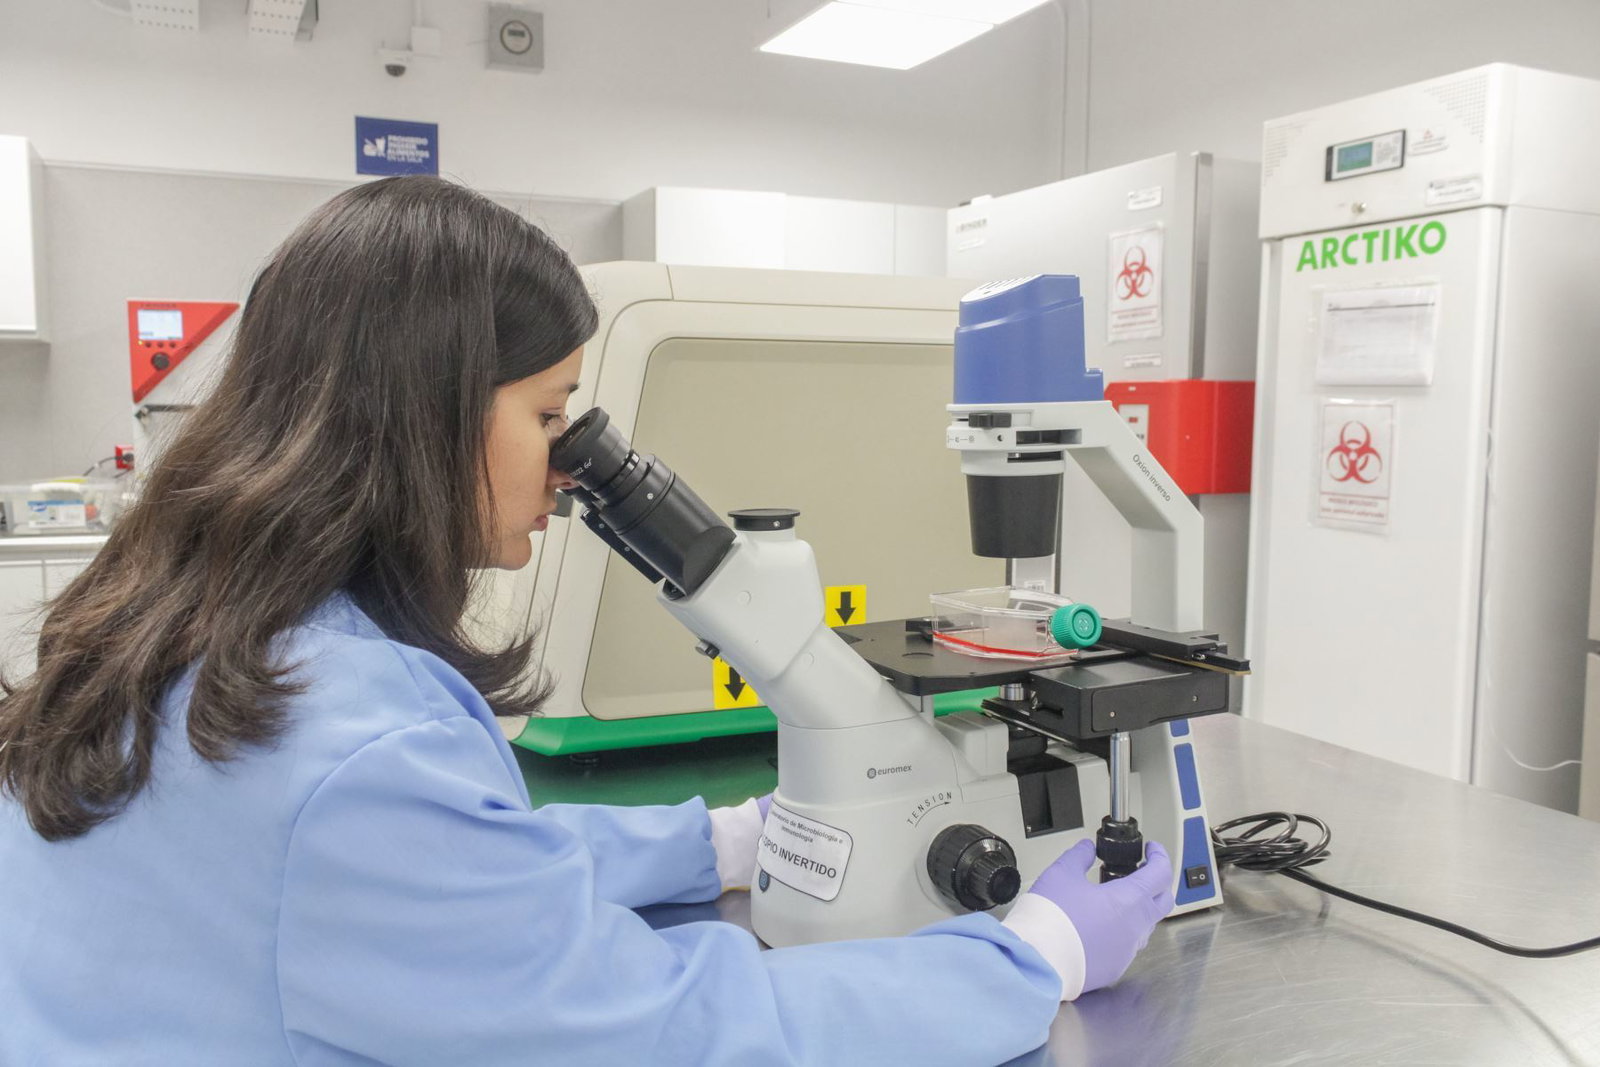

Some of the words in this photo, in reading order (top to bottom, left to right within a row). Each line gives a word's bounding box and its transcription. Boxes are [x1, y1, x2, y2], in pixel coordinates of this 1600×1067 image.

[1296, 220, 1447, 272] ARCTIKO
[1133, 454, 1150, 477] Oxion
[1149, 474, 1171, 502] inverso
[877, 765, 912, 775] euromex
[907, 792, 952, 824] TENSION
[779, 847, 837, 878] INVERTIDO
